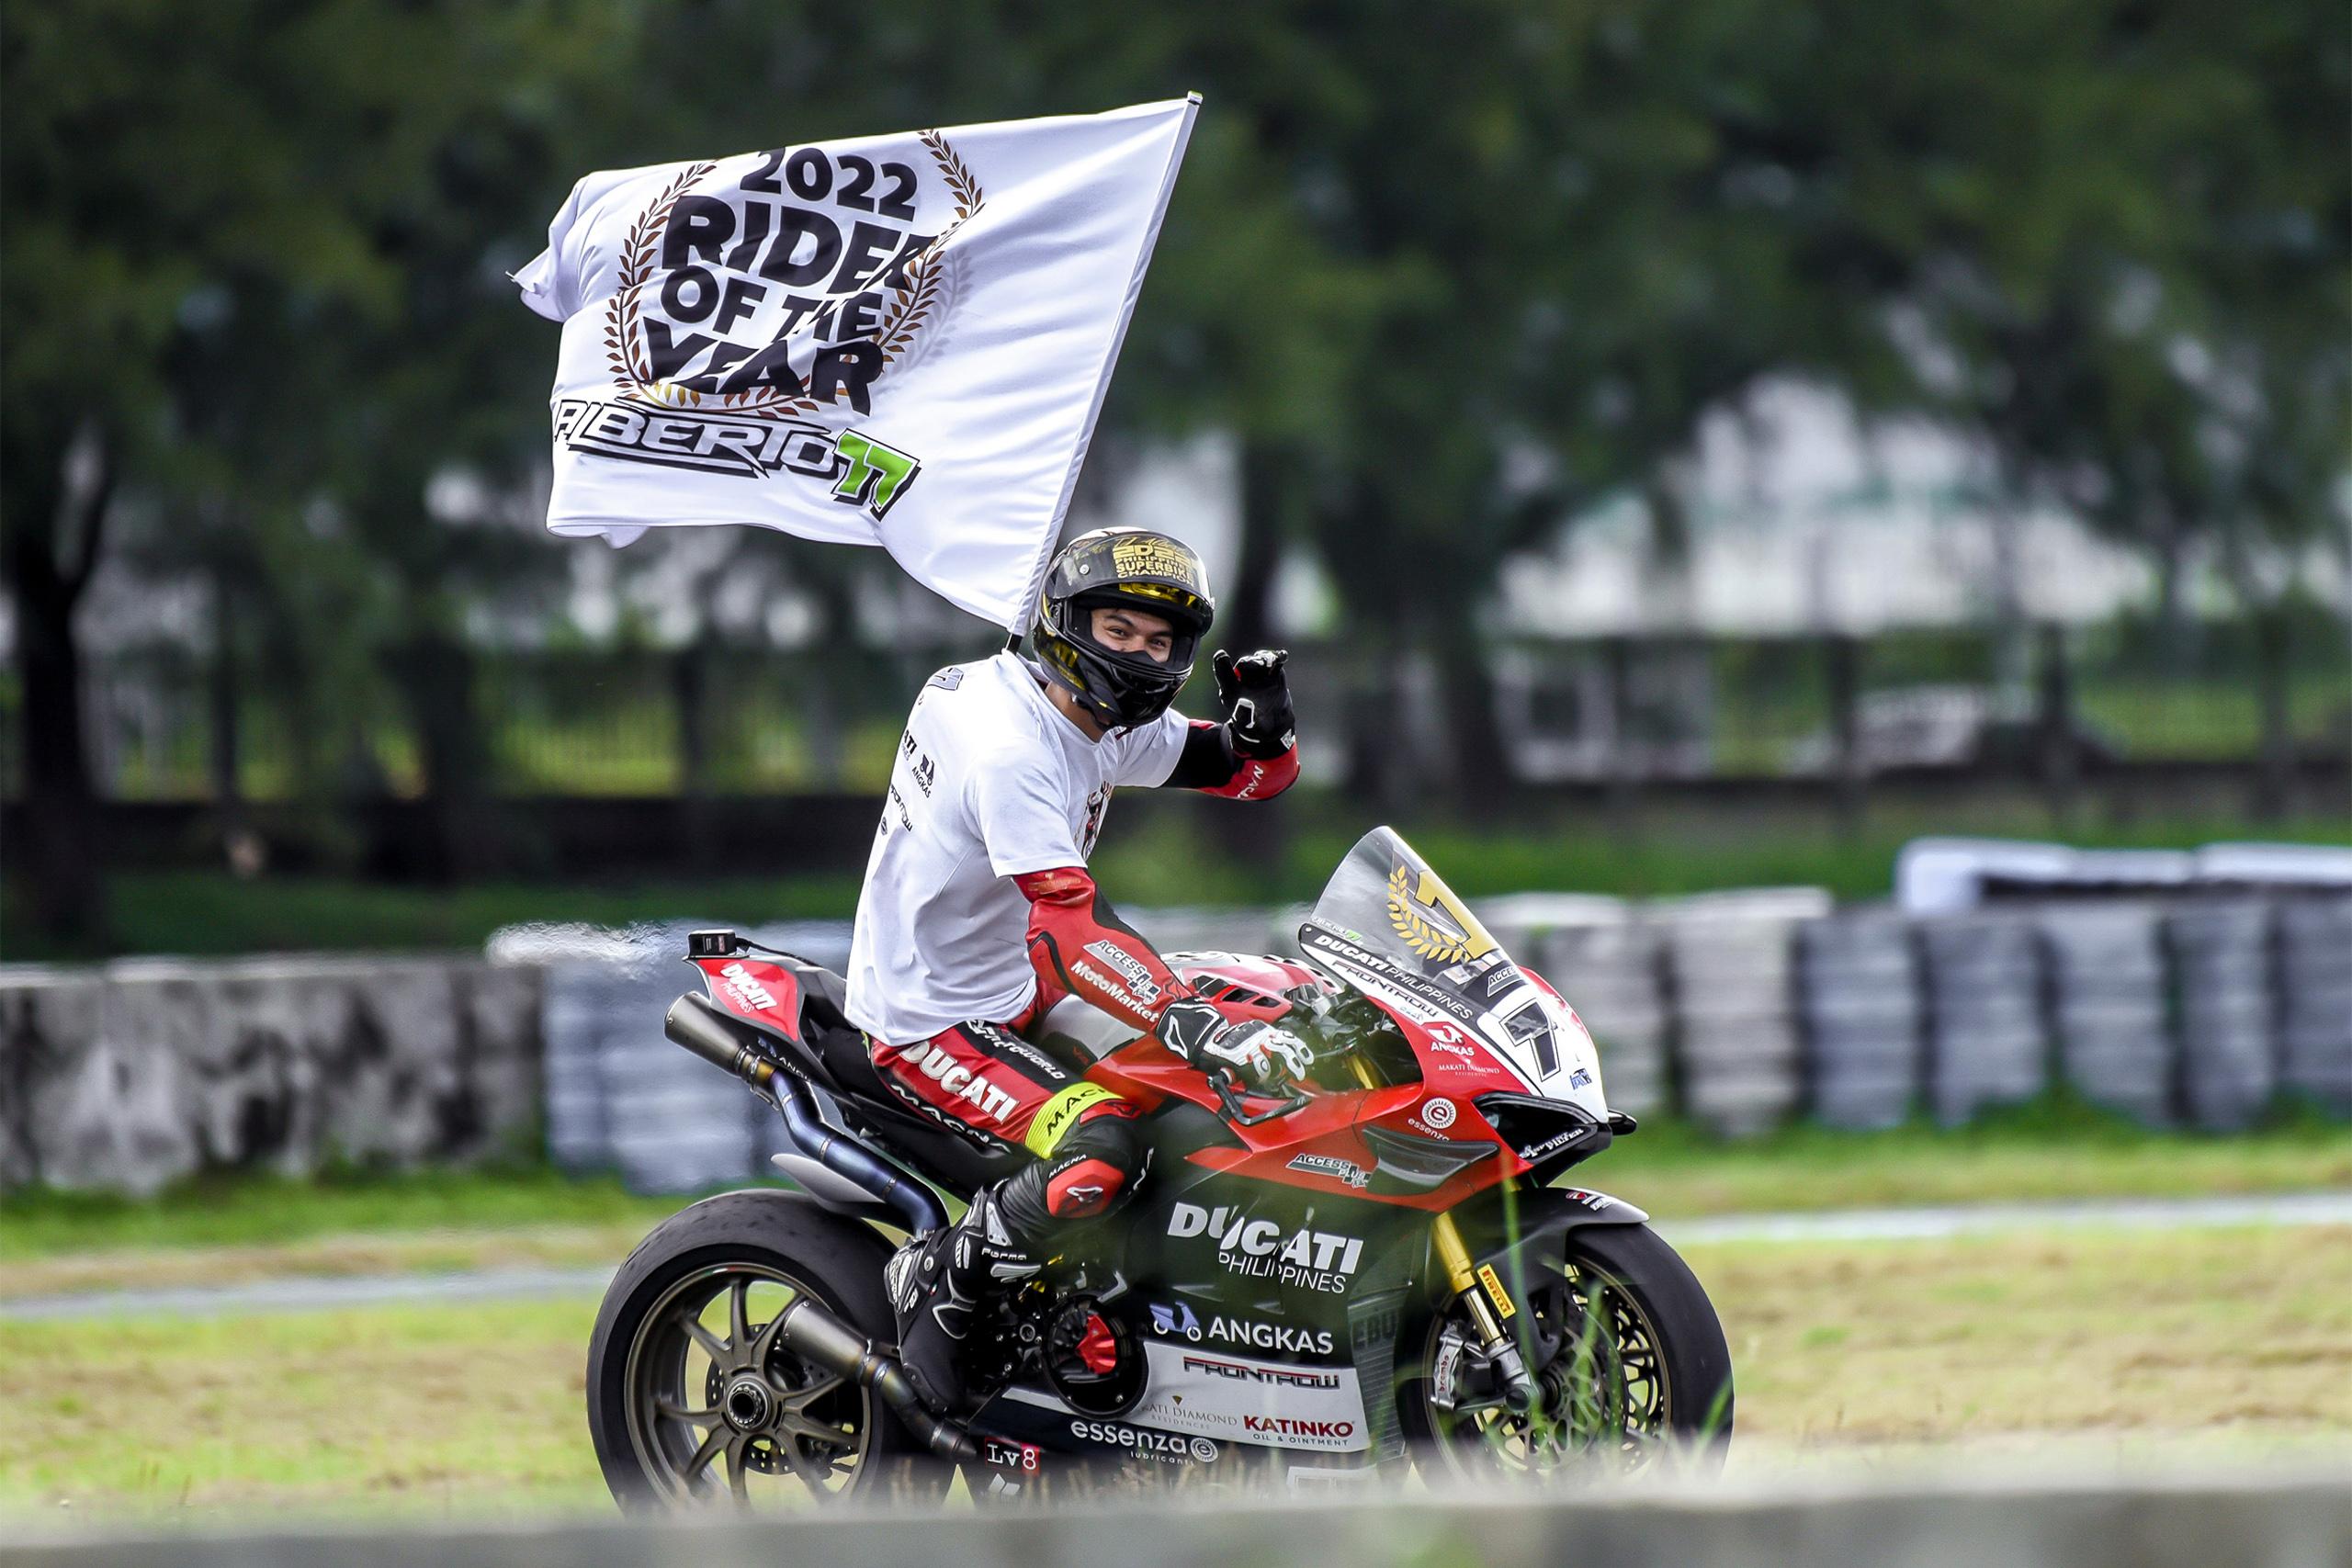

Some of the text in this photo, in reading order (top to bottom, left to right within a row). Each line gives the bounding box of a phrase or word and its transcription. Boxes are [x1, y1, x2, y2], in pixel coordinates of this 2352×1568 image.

[740, 147, 918, 222] 2022
[661, 265, 768, 335] OF
[911, 766, 932, 799] ANGKAS
[1096, 941, 1147, 975] ACCESS
[720, 964, 778, 1010] DUCATI
[1070, 960, 1159, 1023] MotoMarket
[1314, 935, 1473, 1020] DUCATI PHILIPPINES
[1430, 1042, 1475, 1056] ANGKAS
[899, 1040, 1021, 1124] DUCATI
[1048, 1154, 1087, 1179] MAGNA
[1295, 1154, 1351, 1169] ACCESS
[1167, 1201, 1364, 1274] DUCATI
[1218, 1251, 1347, 1294] PHILIPPINES
[1482, 1269, 1512, 1314] PIRELLI
[1208, 1316, 1334, 1355] ANGKAS
[1439, 1354, 1450, 1393] brembo
[1173, 1406, 1238, 1426] DIAMOND
[1243, 1416, 1354, 1438] KATINKO
[1070, 1421, 1187, 1454] essenza
[1253, 1433, 1349, 1447] OIL & OINTMENT
[987, 1443, 1037, 1471] Lv8
[1130, 1450, 1195, 1466] lubricants
